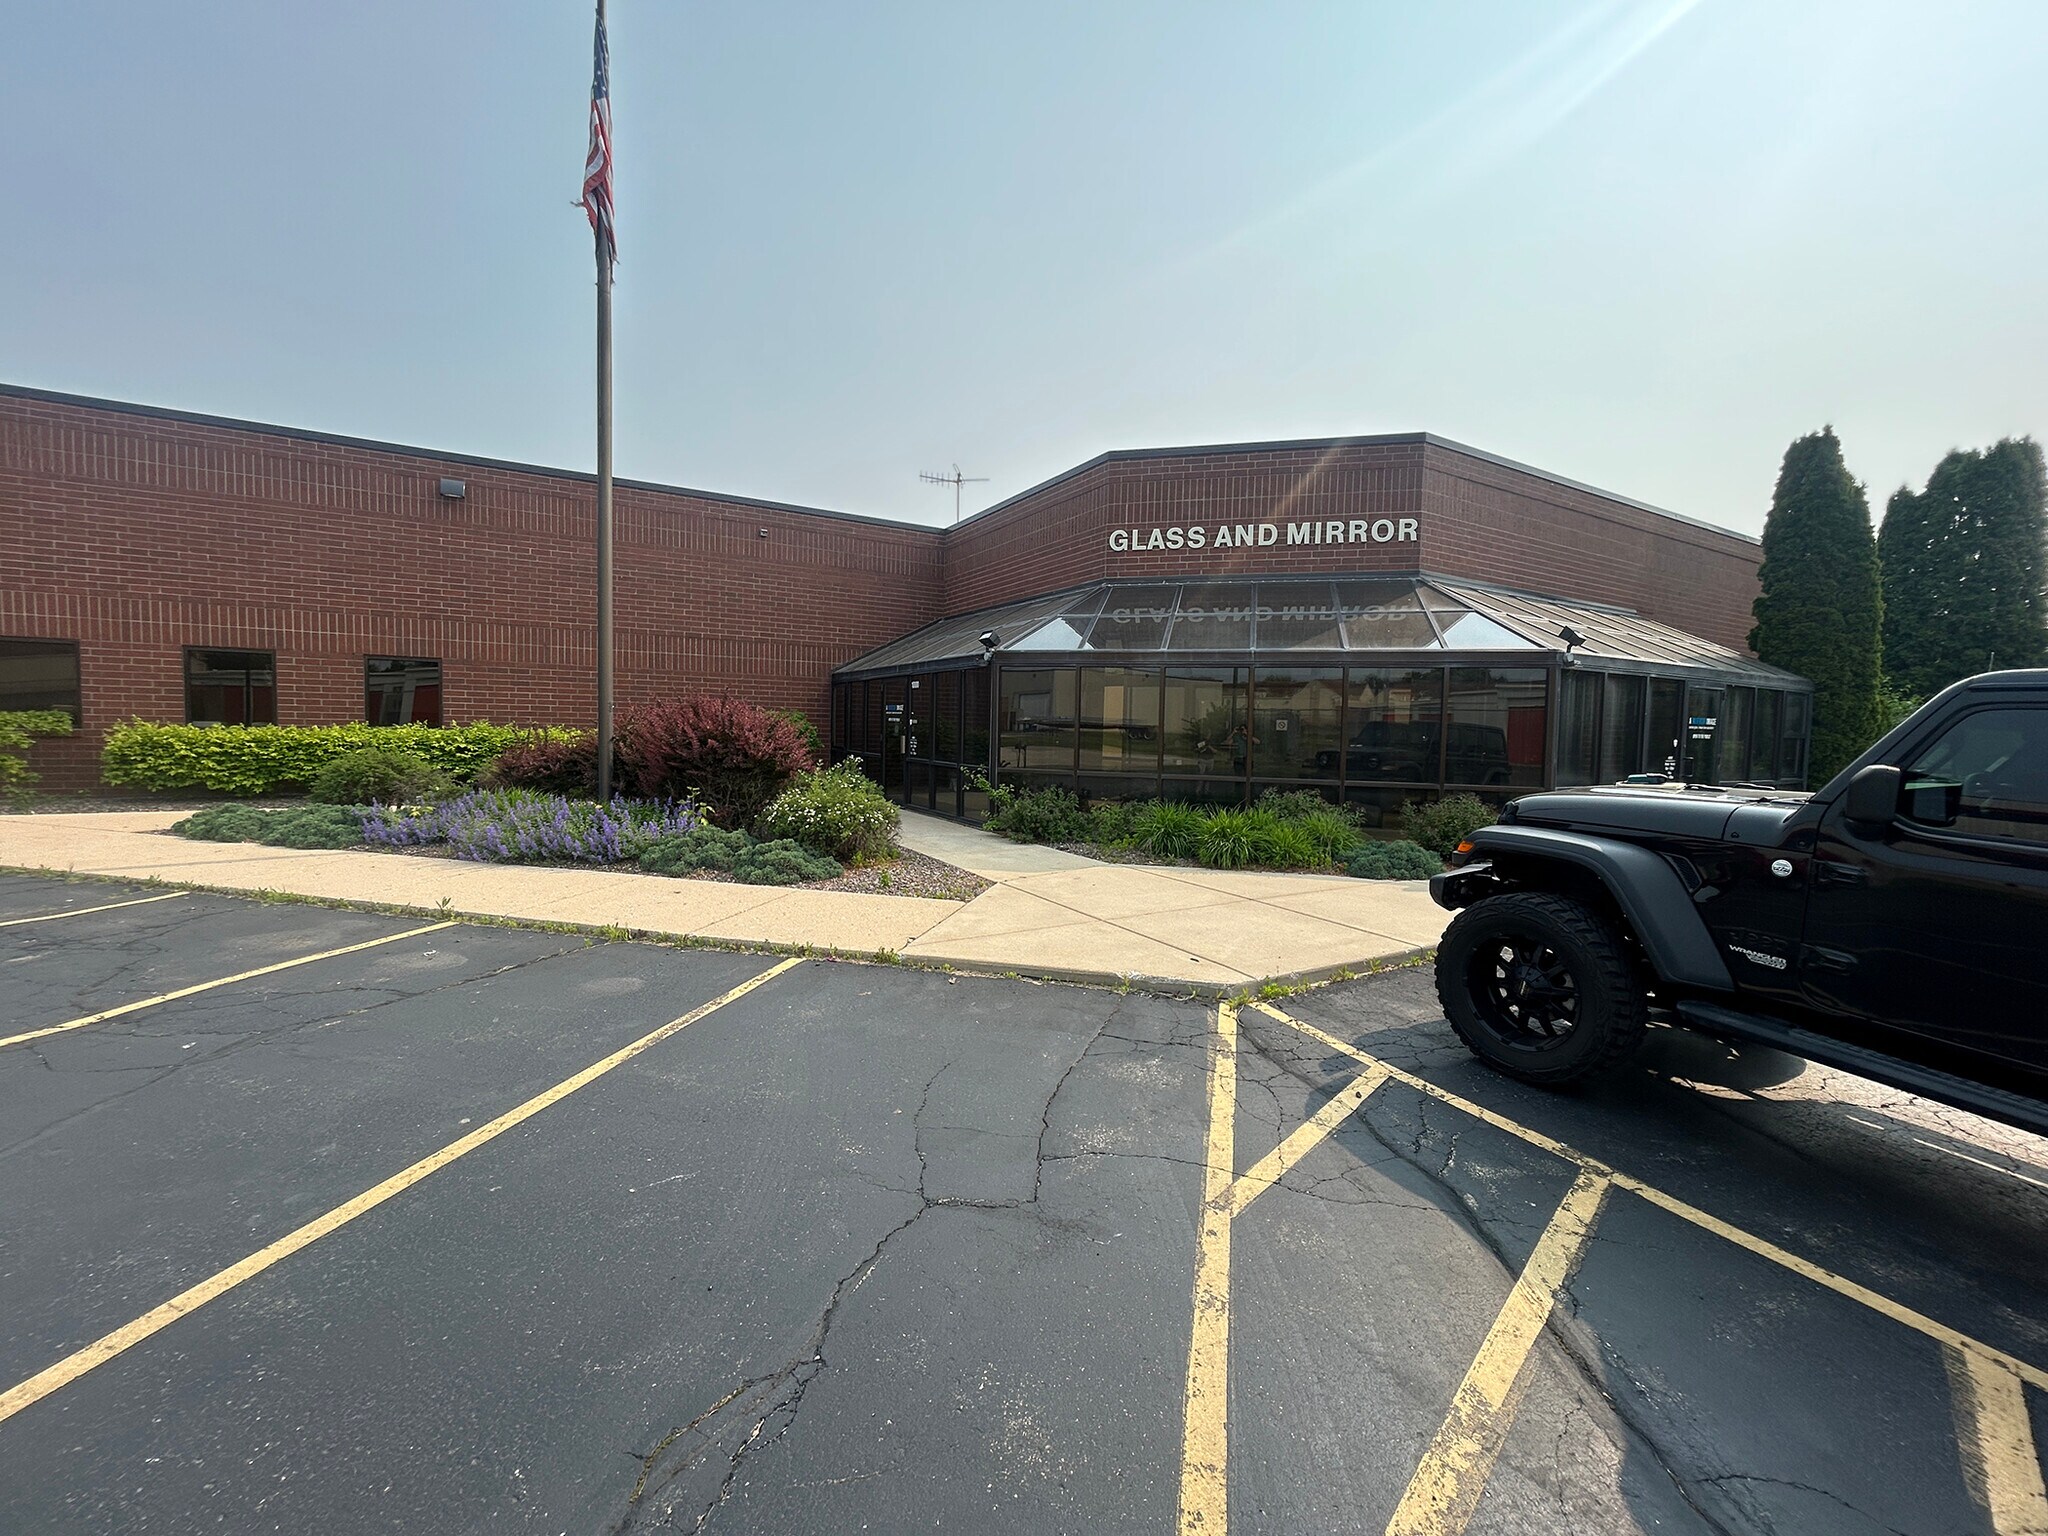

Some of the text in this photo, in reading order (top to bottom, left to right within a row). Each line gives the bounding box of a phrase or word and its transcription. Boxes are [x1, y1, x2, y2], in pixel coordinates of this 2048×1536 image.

[1109, 518, 1419, 551] GLASS AND MIRROR
[1728, 944, 1787, 963] WRANGLER
